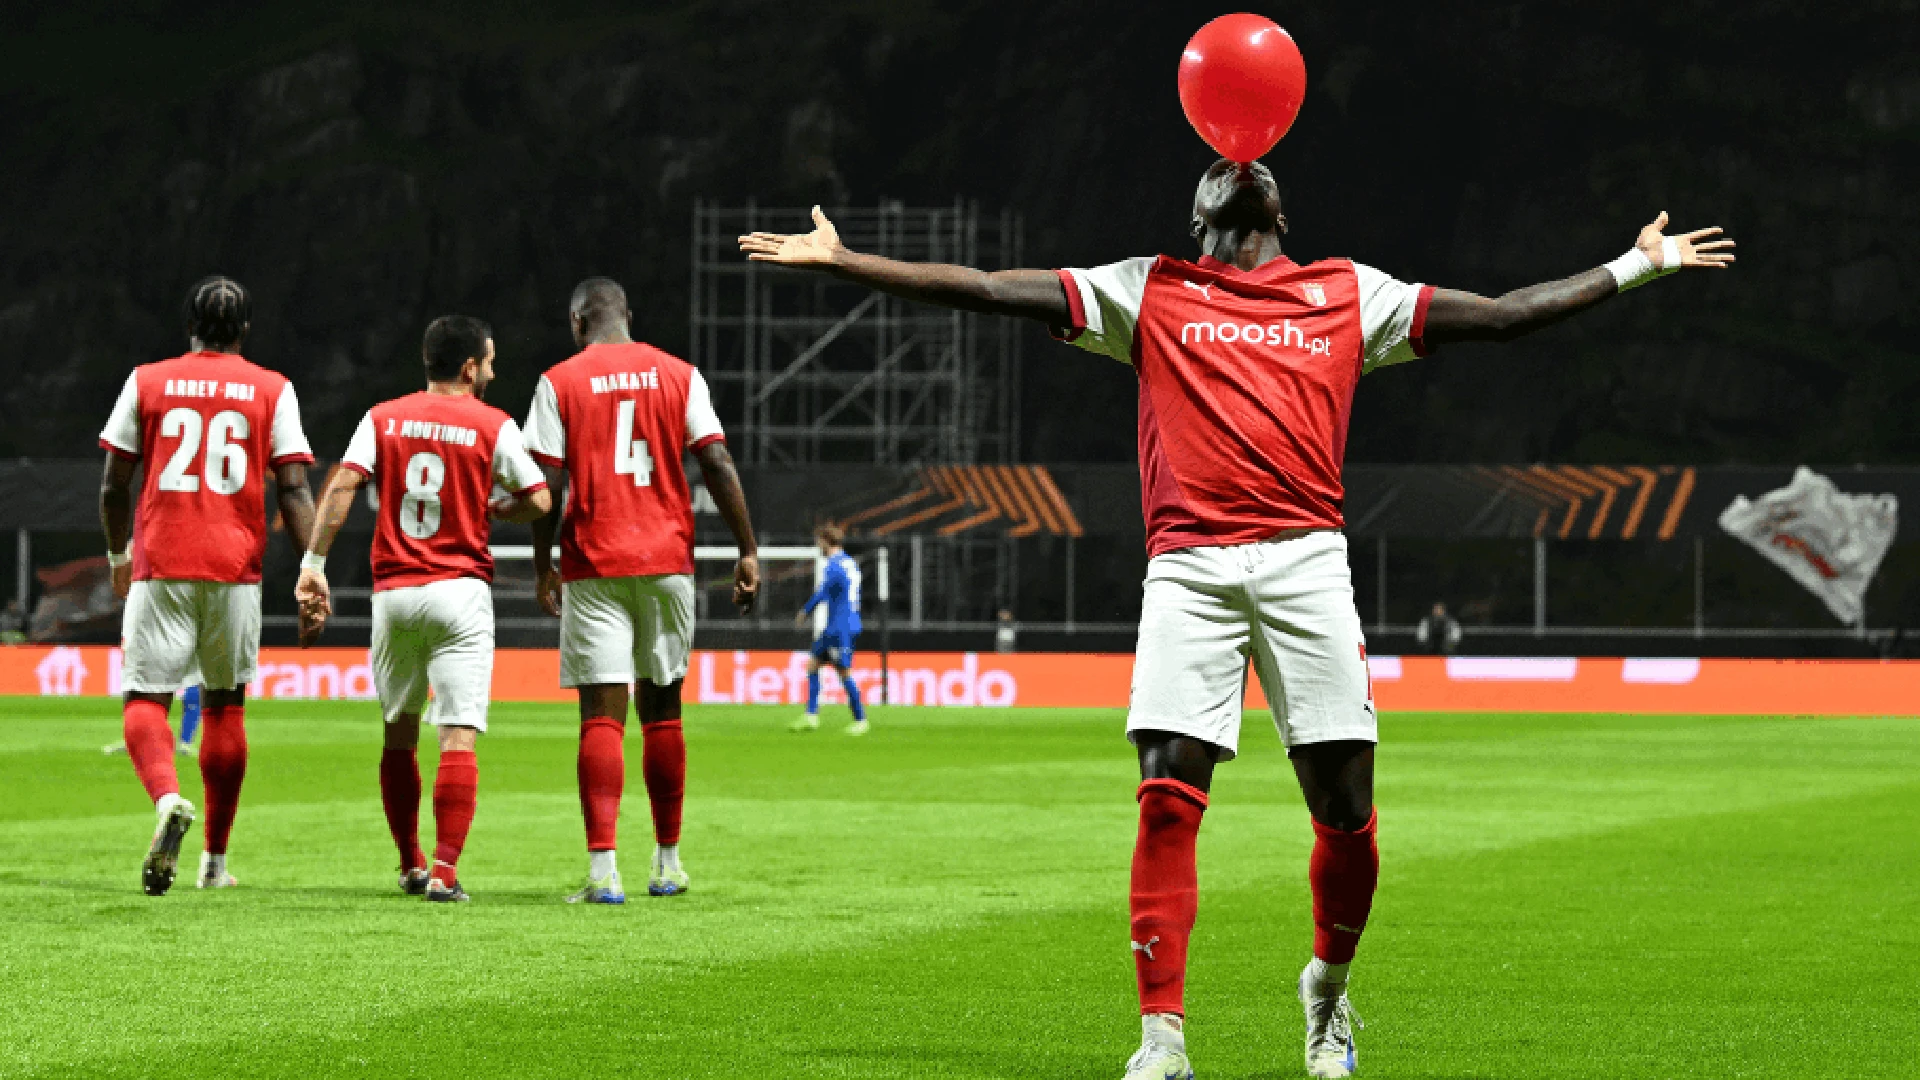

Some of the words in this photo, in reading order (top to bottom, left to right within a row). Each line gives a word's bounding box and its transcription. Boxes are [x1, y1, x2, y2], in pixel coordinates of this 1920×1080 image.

[1181, 318, 1331, 357] moosh.pt
[158, 407, 250, 495] 26
[400, 419, 477, 447] MOUTINHO
[614, 399, 657, 487] 4
[399, 452, 446, 539] 8
